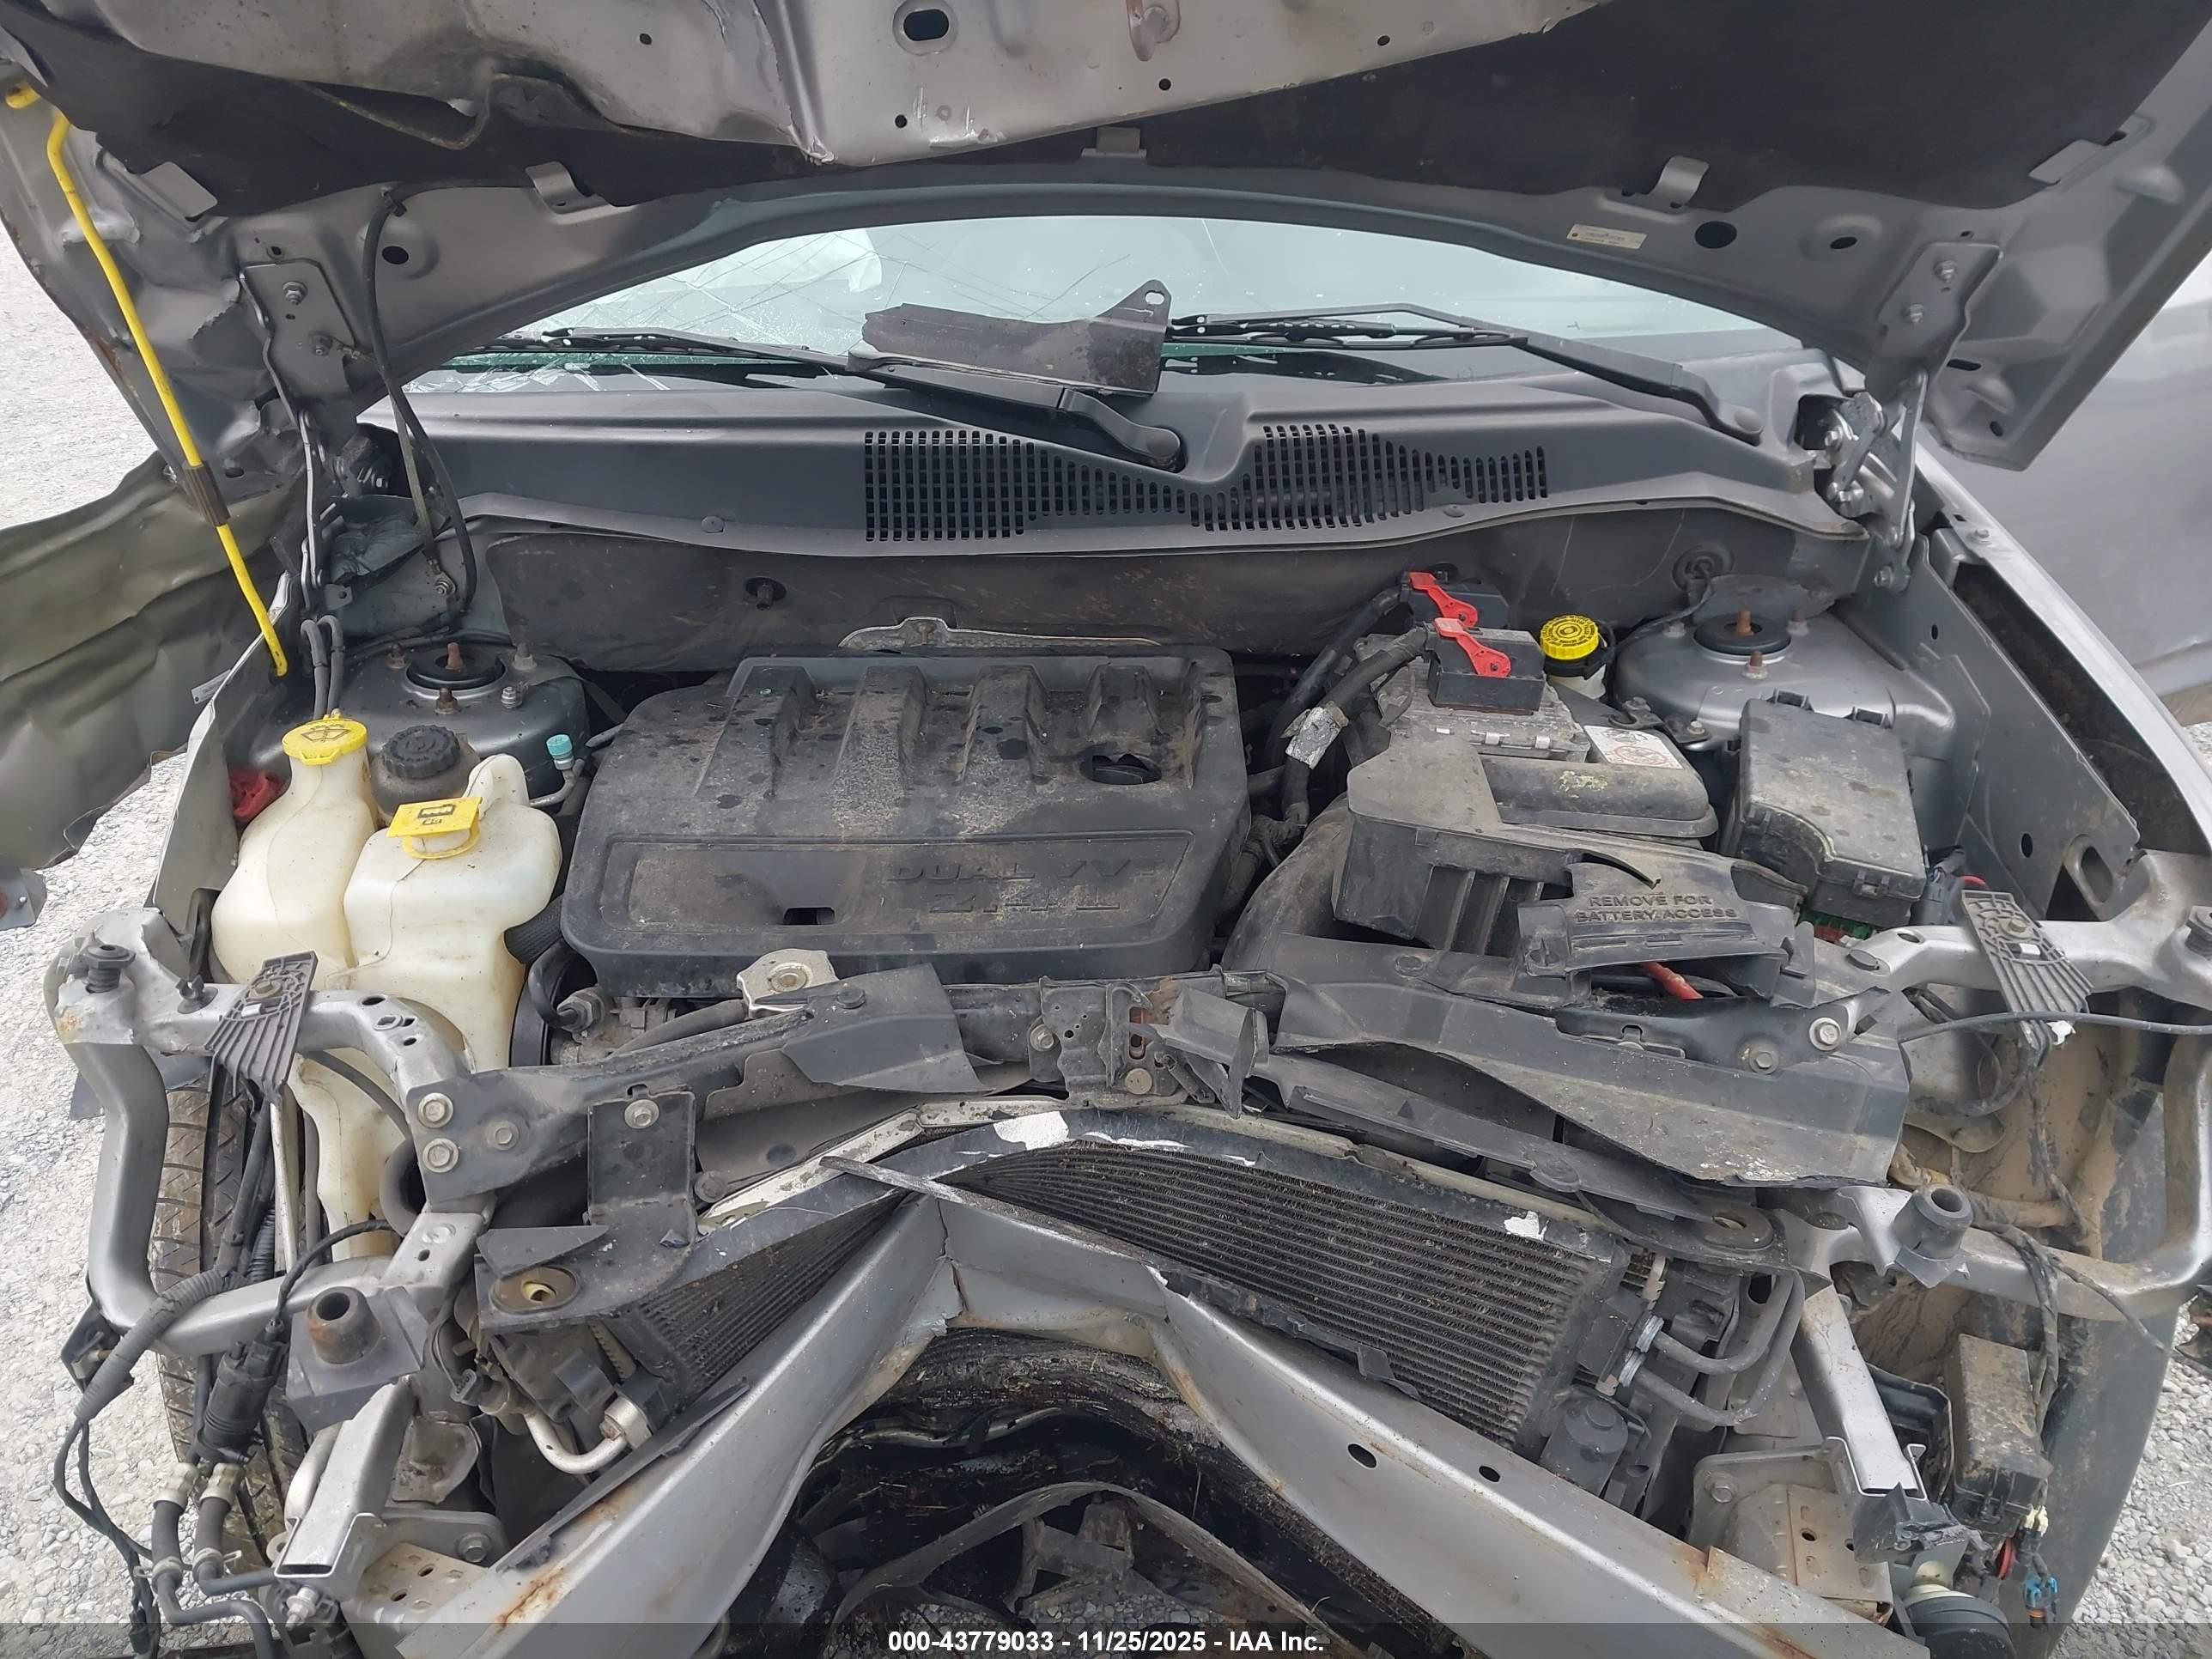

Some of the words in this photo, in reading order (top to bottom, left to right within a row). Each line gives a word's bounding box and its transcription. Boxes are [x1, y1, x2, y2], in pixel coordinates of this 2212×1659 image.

[887, 861, 1036, 883] DUAL
[1589, 895, 1668, 908] REMOVE
[1673, 894, 1713, 906] FOR
[1575, 909, 1657, 922] BATTERY
[1663, 908, 1738, 920] ACCESS
